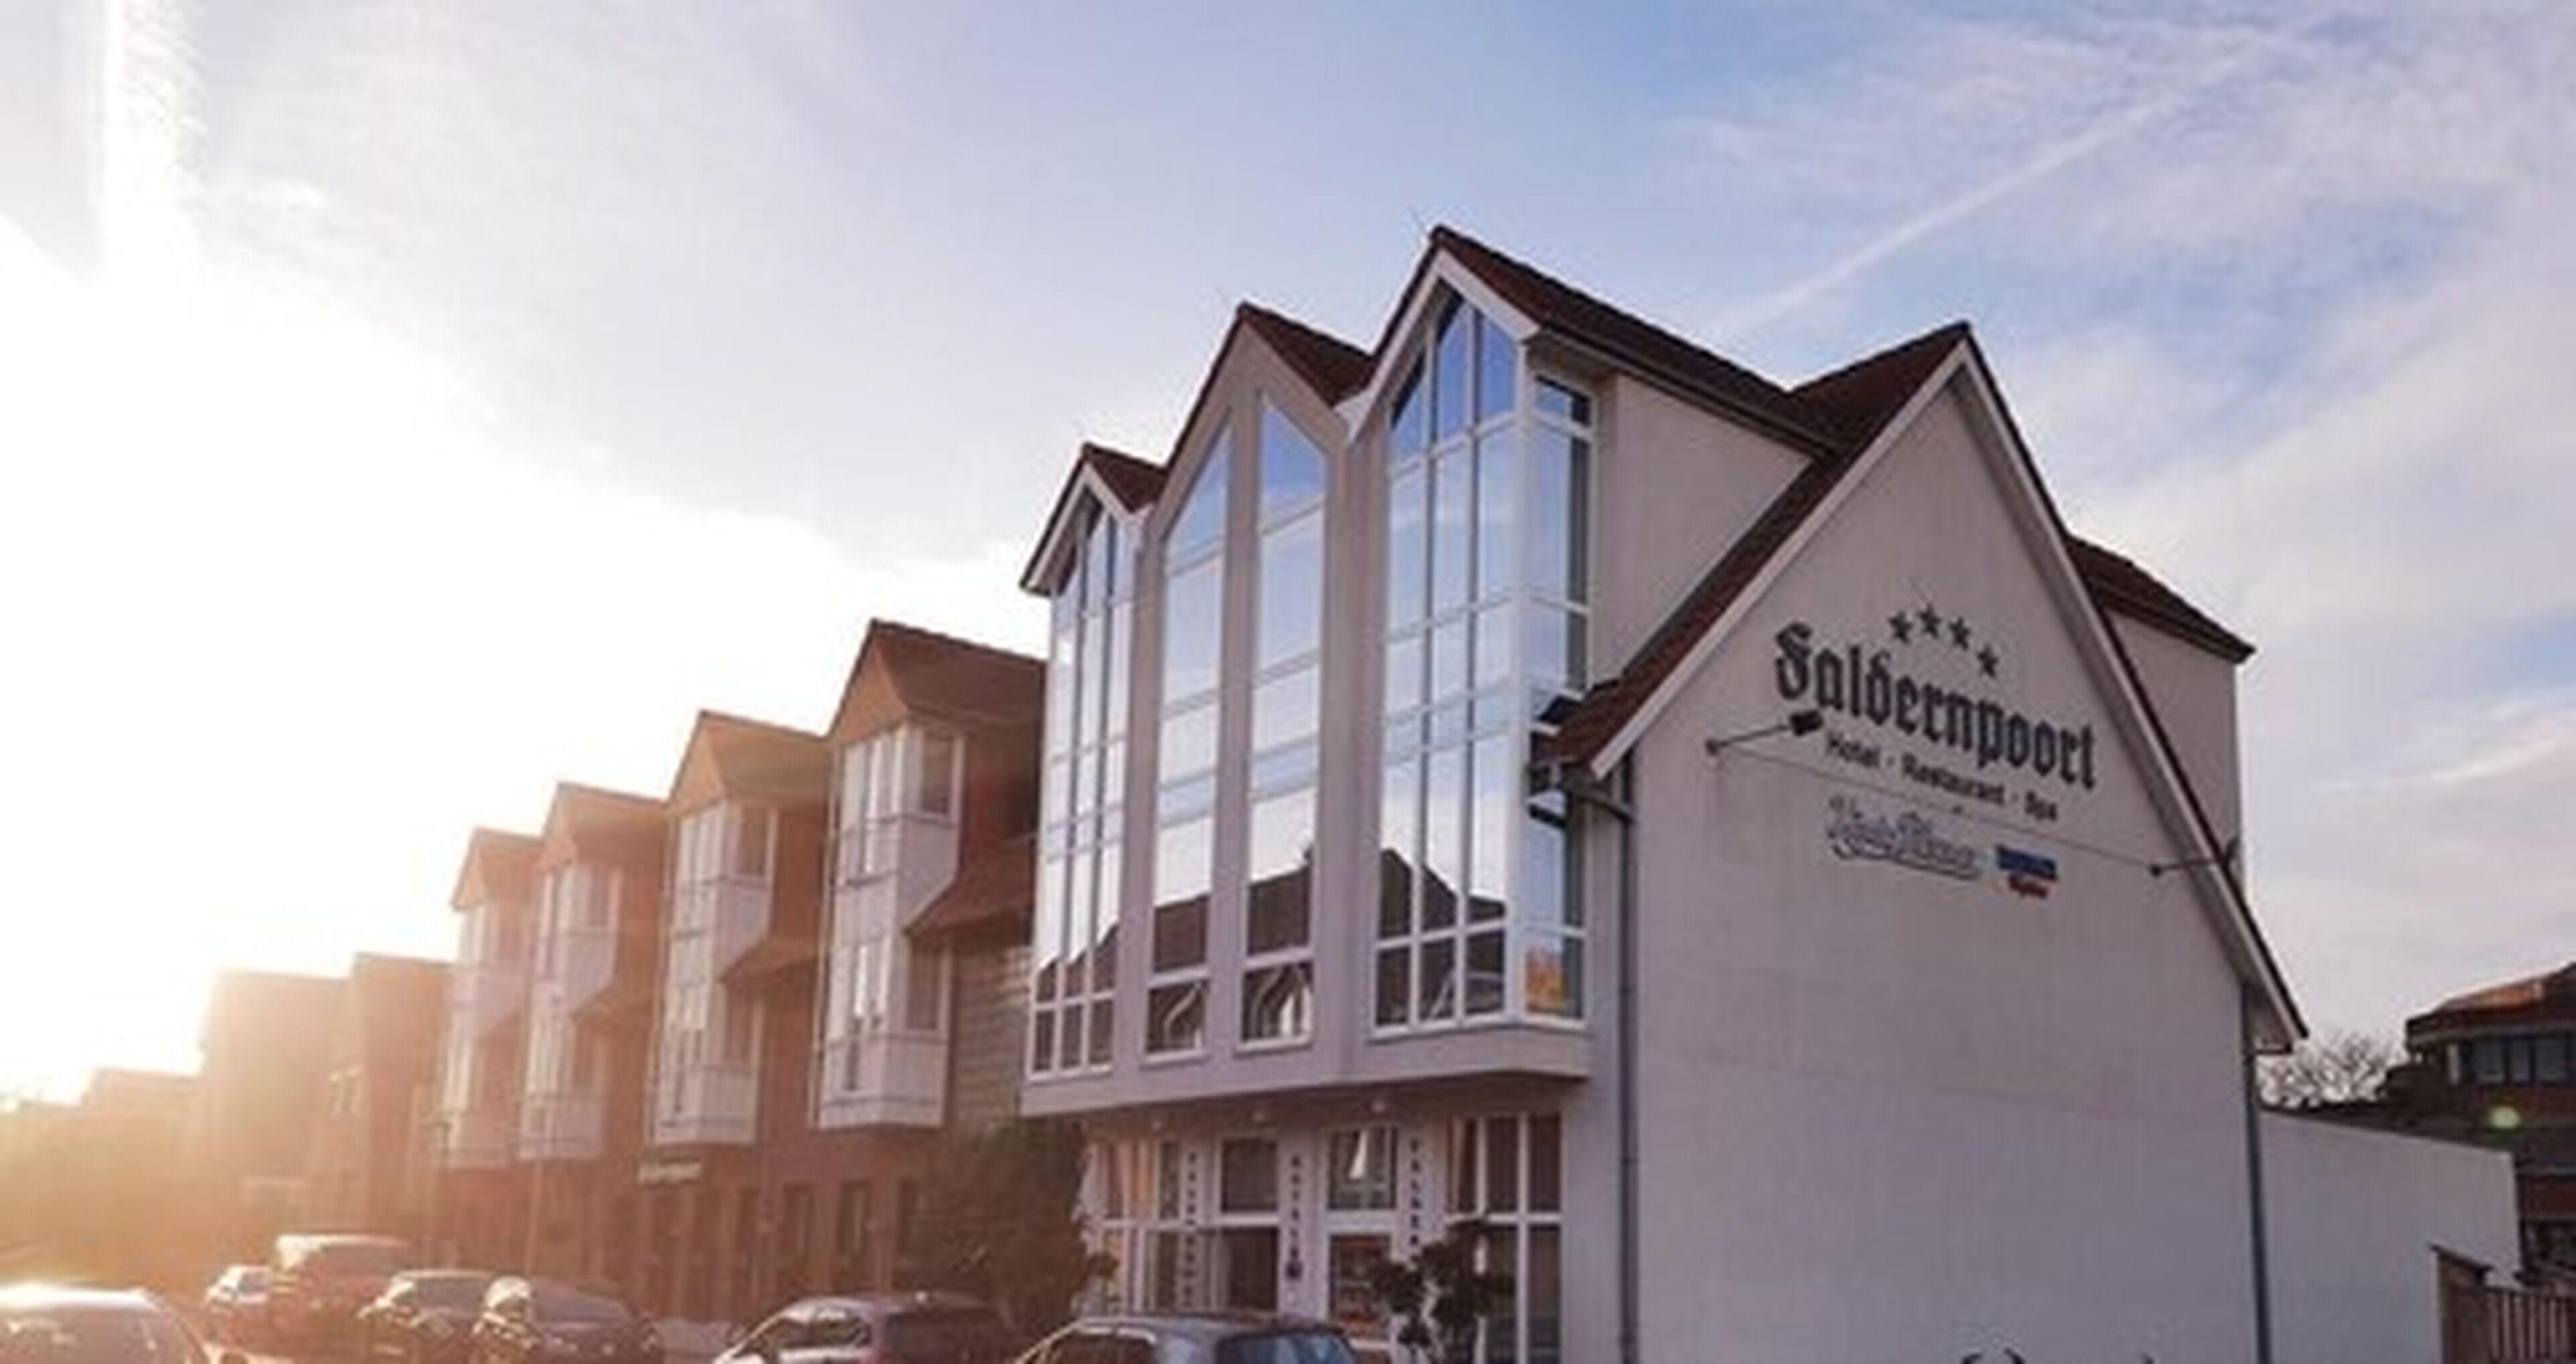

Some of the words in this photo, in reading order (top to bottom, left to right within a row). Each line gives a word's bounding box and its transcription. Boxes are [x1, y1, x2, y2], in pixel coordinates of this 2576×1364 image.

[1775, 622, 2094, 790] Faldernpoort
[1826, 730, 1879, 769] Hotel
[1902, 752, 2004, 806] Restaurant
[2024, 790, 2058, 822] Spa
